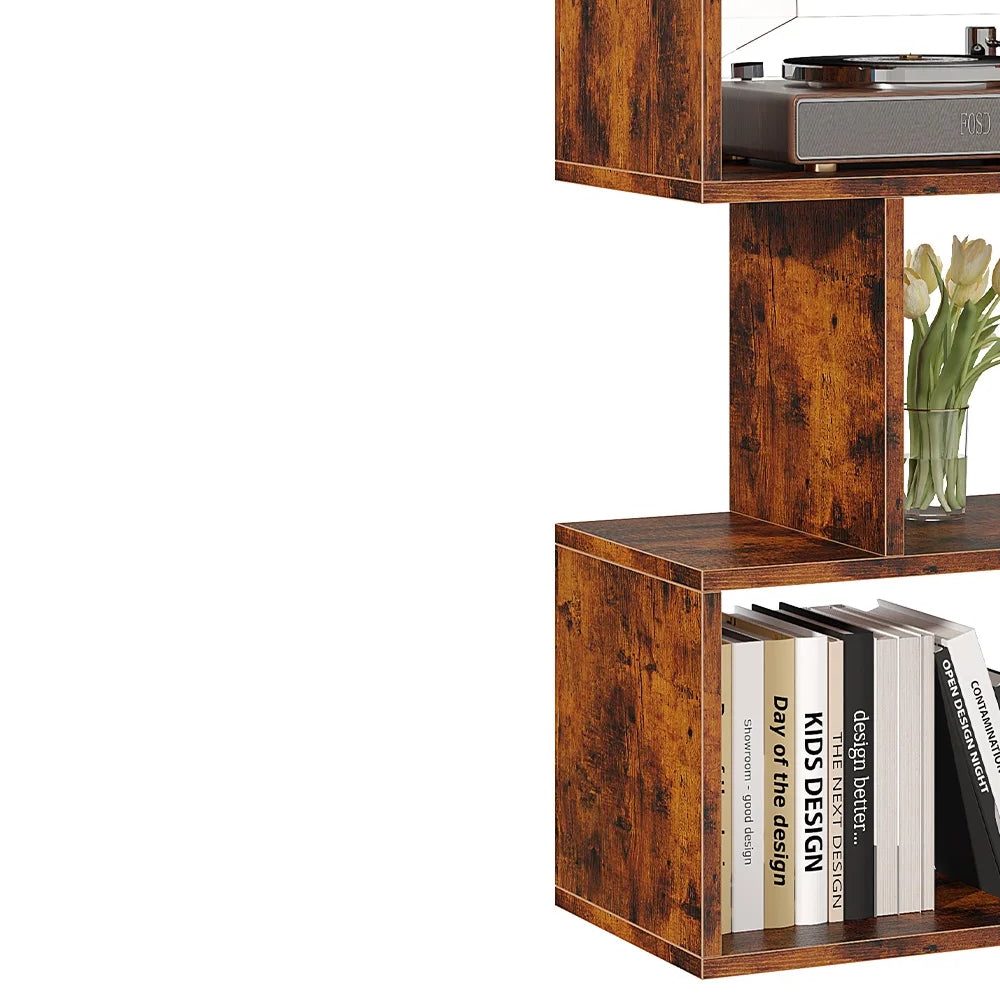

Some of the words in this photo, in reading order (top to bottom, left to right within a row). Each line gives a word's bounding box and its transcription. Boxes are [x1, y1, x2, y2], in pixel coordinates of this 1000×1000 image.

[769, 696, 788, 737] Day
[804, 712, 823, 771] KIDS
[848, 709, 869, 772] design
[942, 658, 961, 698] OPEN
[954, 699, 976, 750] DESIGN
[969, 750, 989, 794] NIGHT
[743, 719, 753, 781] Showroom
[773, 744, 788, 769] of
[832, 732, 843, 769] THE
[741, 794, 754, 823] good
[773, 771, 788, 808] the
[832, 776, 843, 828] NEXT
[853, 776, 869, 845] better...
[741, 828, 754, 866] design
[769, 815, 788, 886] design
[804, 778, 823, 872] DESIGN
[832, 835, 843, 909] DESIGN
